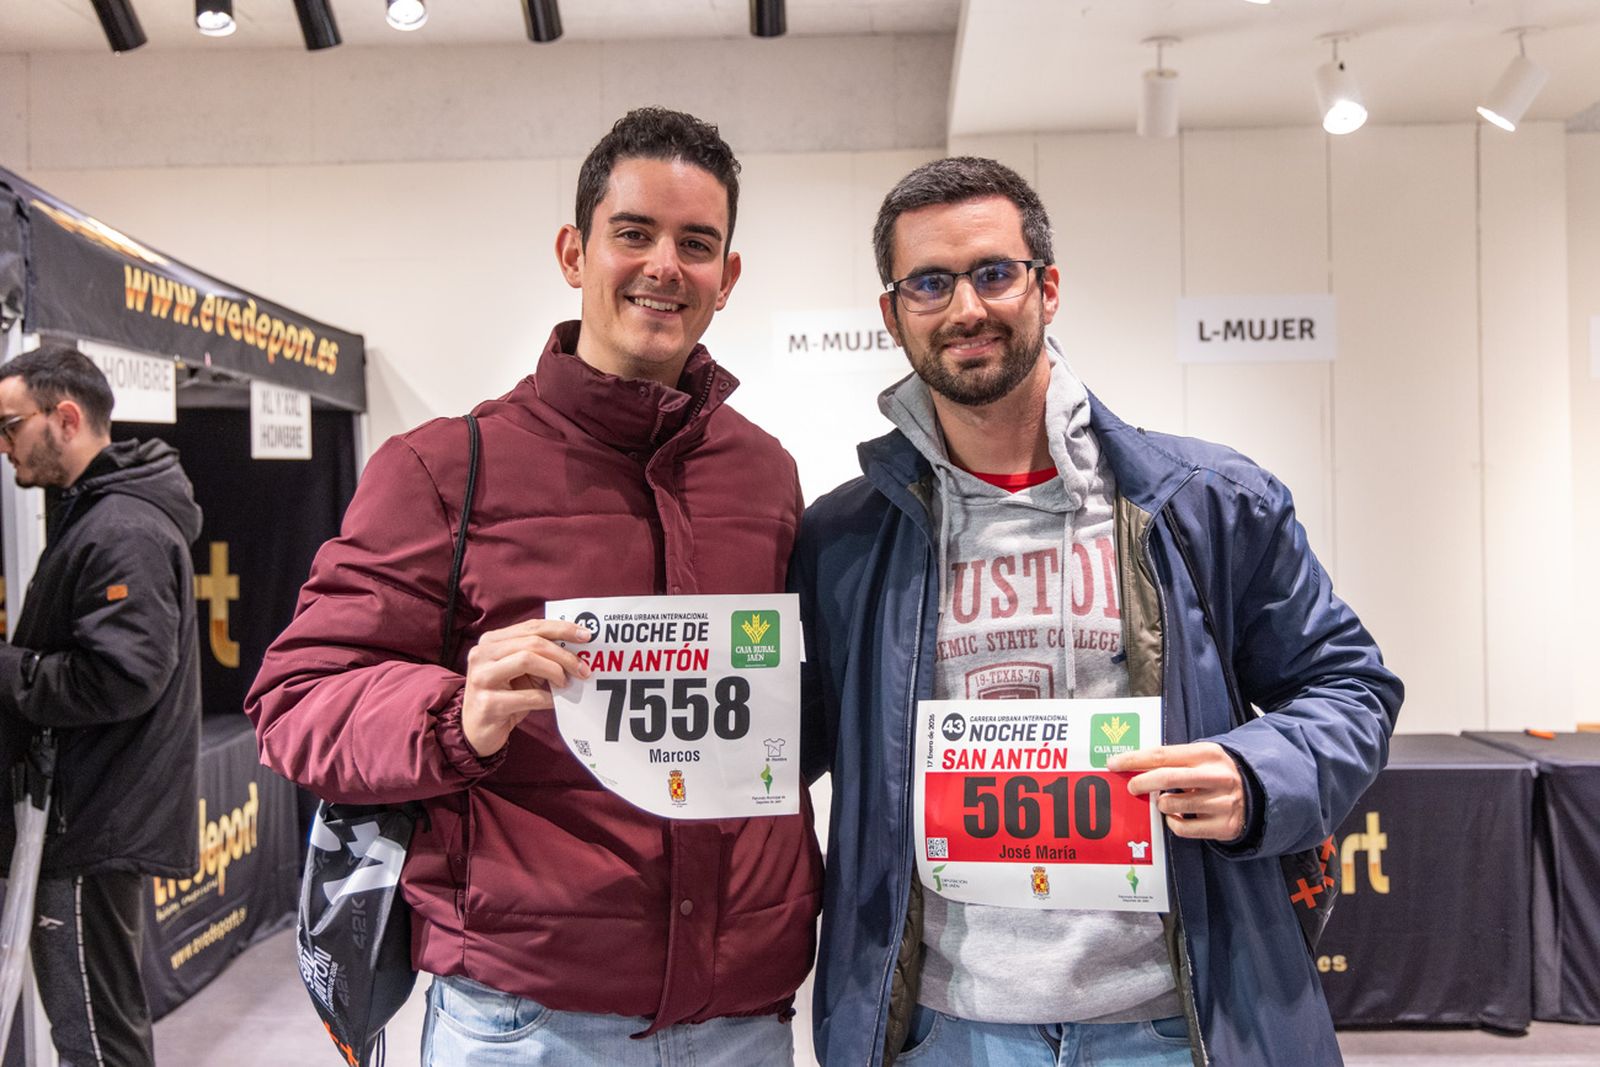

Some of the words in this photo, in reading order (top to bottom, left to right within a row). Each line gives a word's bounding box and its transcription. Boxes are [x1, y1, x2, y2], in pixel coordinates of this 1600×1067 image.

[124, 264, 339, 376] www.evedeport.es
[1198, 318, 1315, 342] L-MUJER
[788, 330, 897, 353] M-MUJE
[102, 355, 171, 391] HOMBRE
[259, 423, 304, 449] HOMBRE
[604, 613, 633, 621] CARRERA
[634, 613, 660, 621] URBANA
[661, 612, 709, 620] INTERNACIONAL
[604, 622, 678, 643] NOCHE
[682, 621, 710, 642] DE
[986, 628, 1038, 651] STATE
[577, 649, 625, 672] SAN
[628, 643, 710, 672] ANTÓN
[974, 668, 1041, 688] 19-TEXAS-76
[596, 676, 750, 742] 7558
[942, 719, 964, 734] 43
[969, 723, 1037, 742] NOCHE
[1042, 723, 1068, 741] DE
[649, 748, 701, 763] Marcos
[942, 748, 987, 770] SAN
[991, 742, 1068, 770] ANTÓN
[963, 775, 1112, 840] 5610
[999, 845, 1031, 859] José
[1036, 844, 1077, 860] María
[1340, 812, 1390, 894] rt
